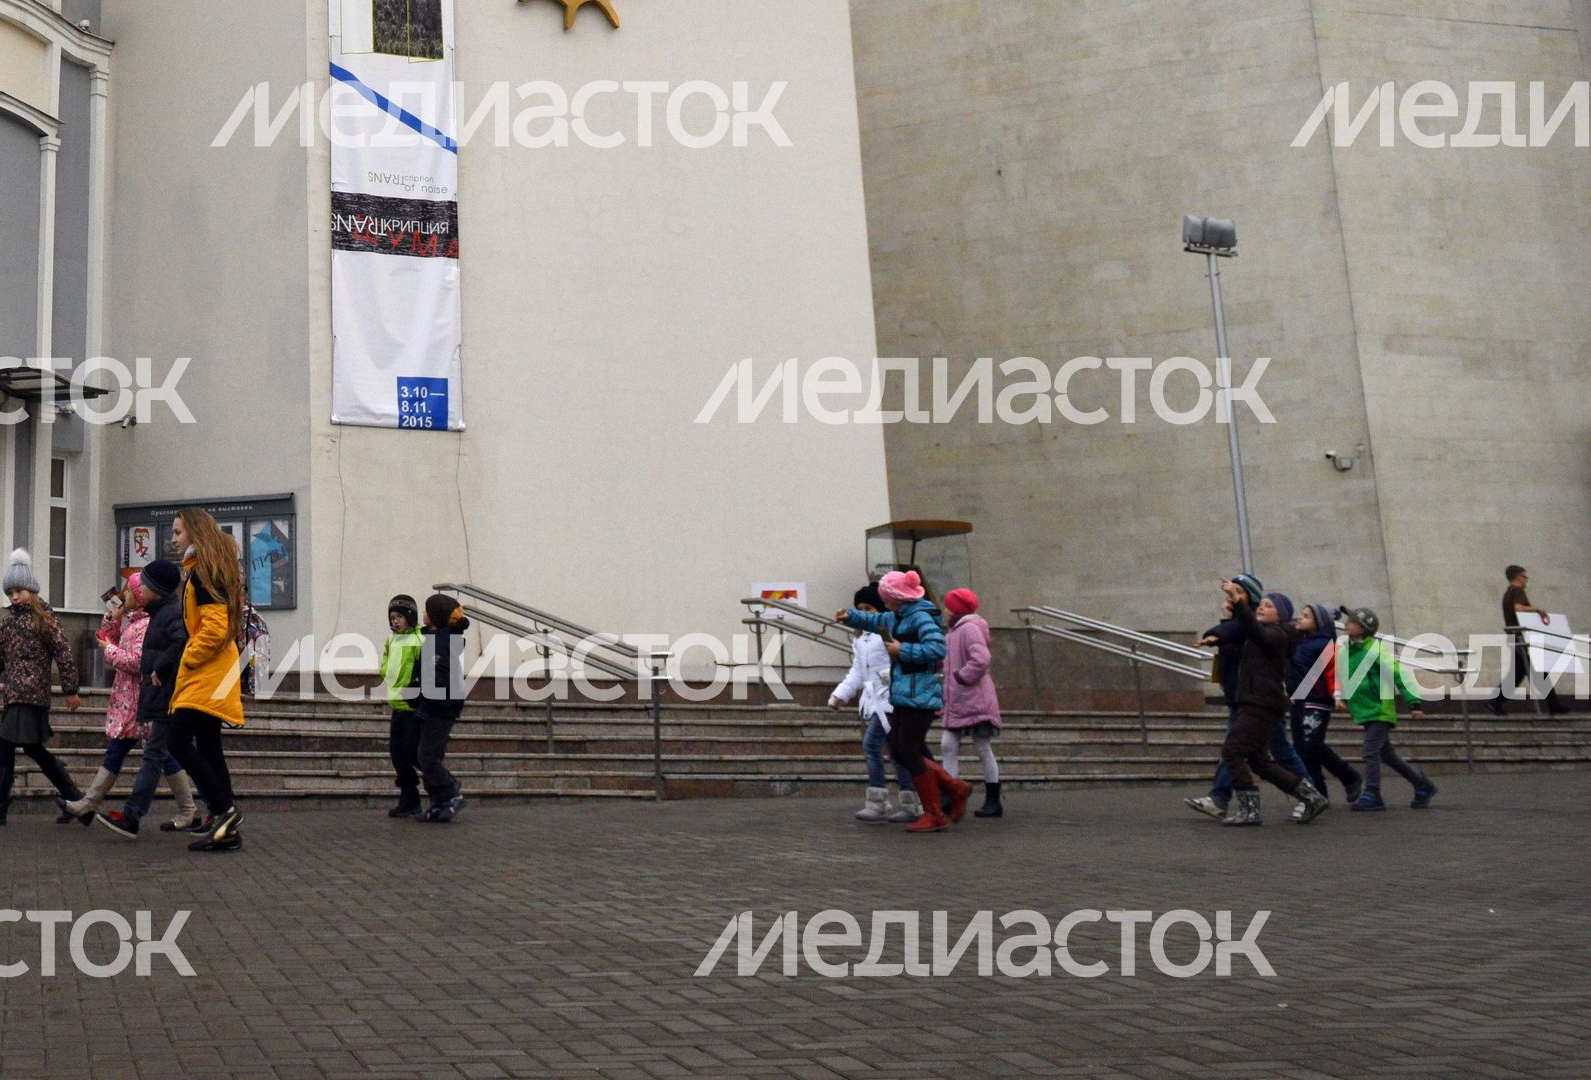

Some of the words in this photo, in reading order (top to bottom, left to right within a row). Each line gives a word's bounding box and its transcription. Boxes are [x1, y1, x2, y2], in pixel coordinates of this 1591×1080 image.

[404, 183, 416, 192] of
[421, 185, 448, 194] noise
[401, 400, 431, 413] 8.11.
[402, 415, 432, 428] 2015
